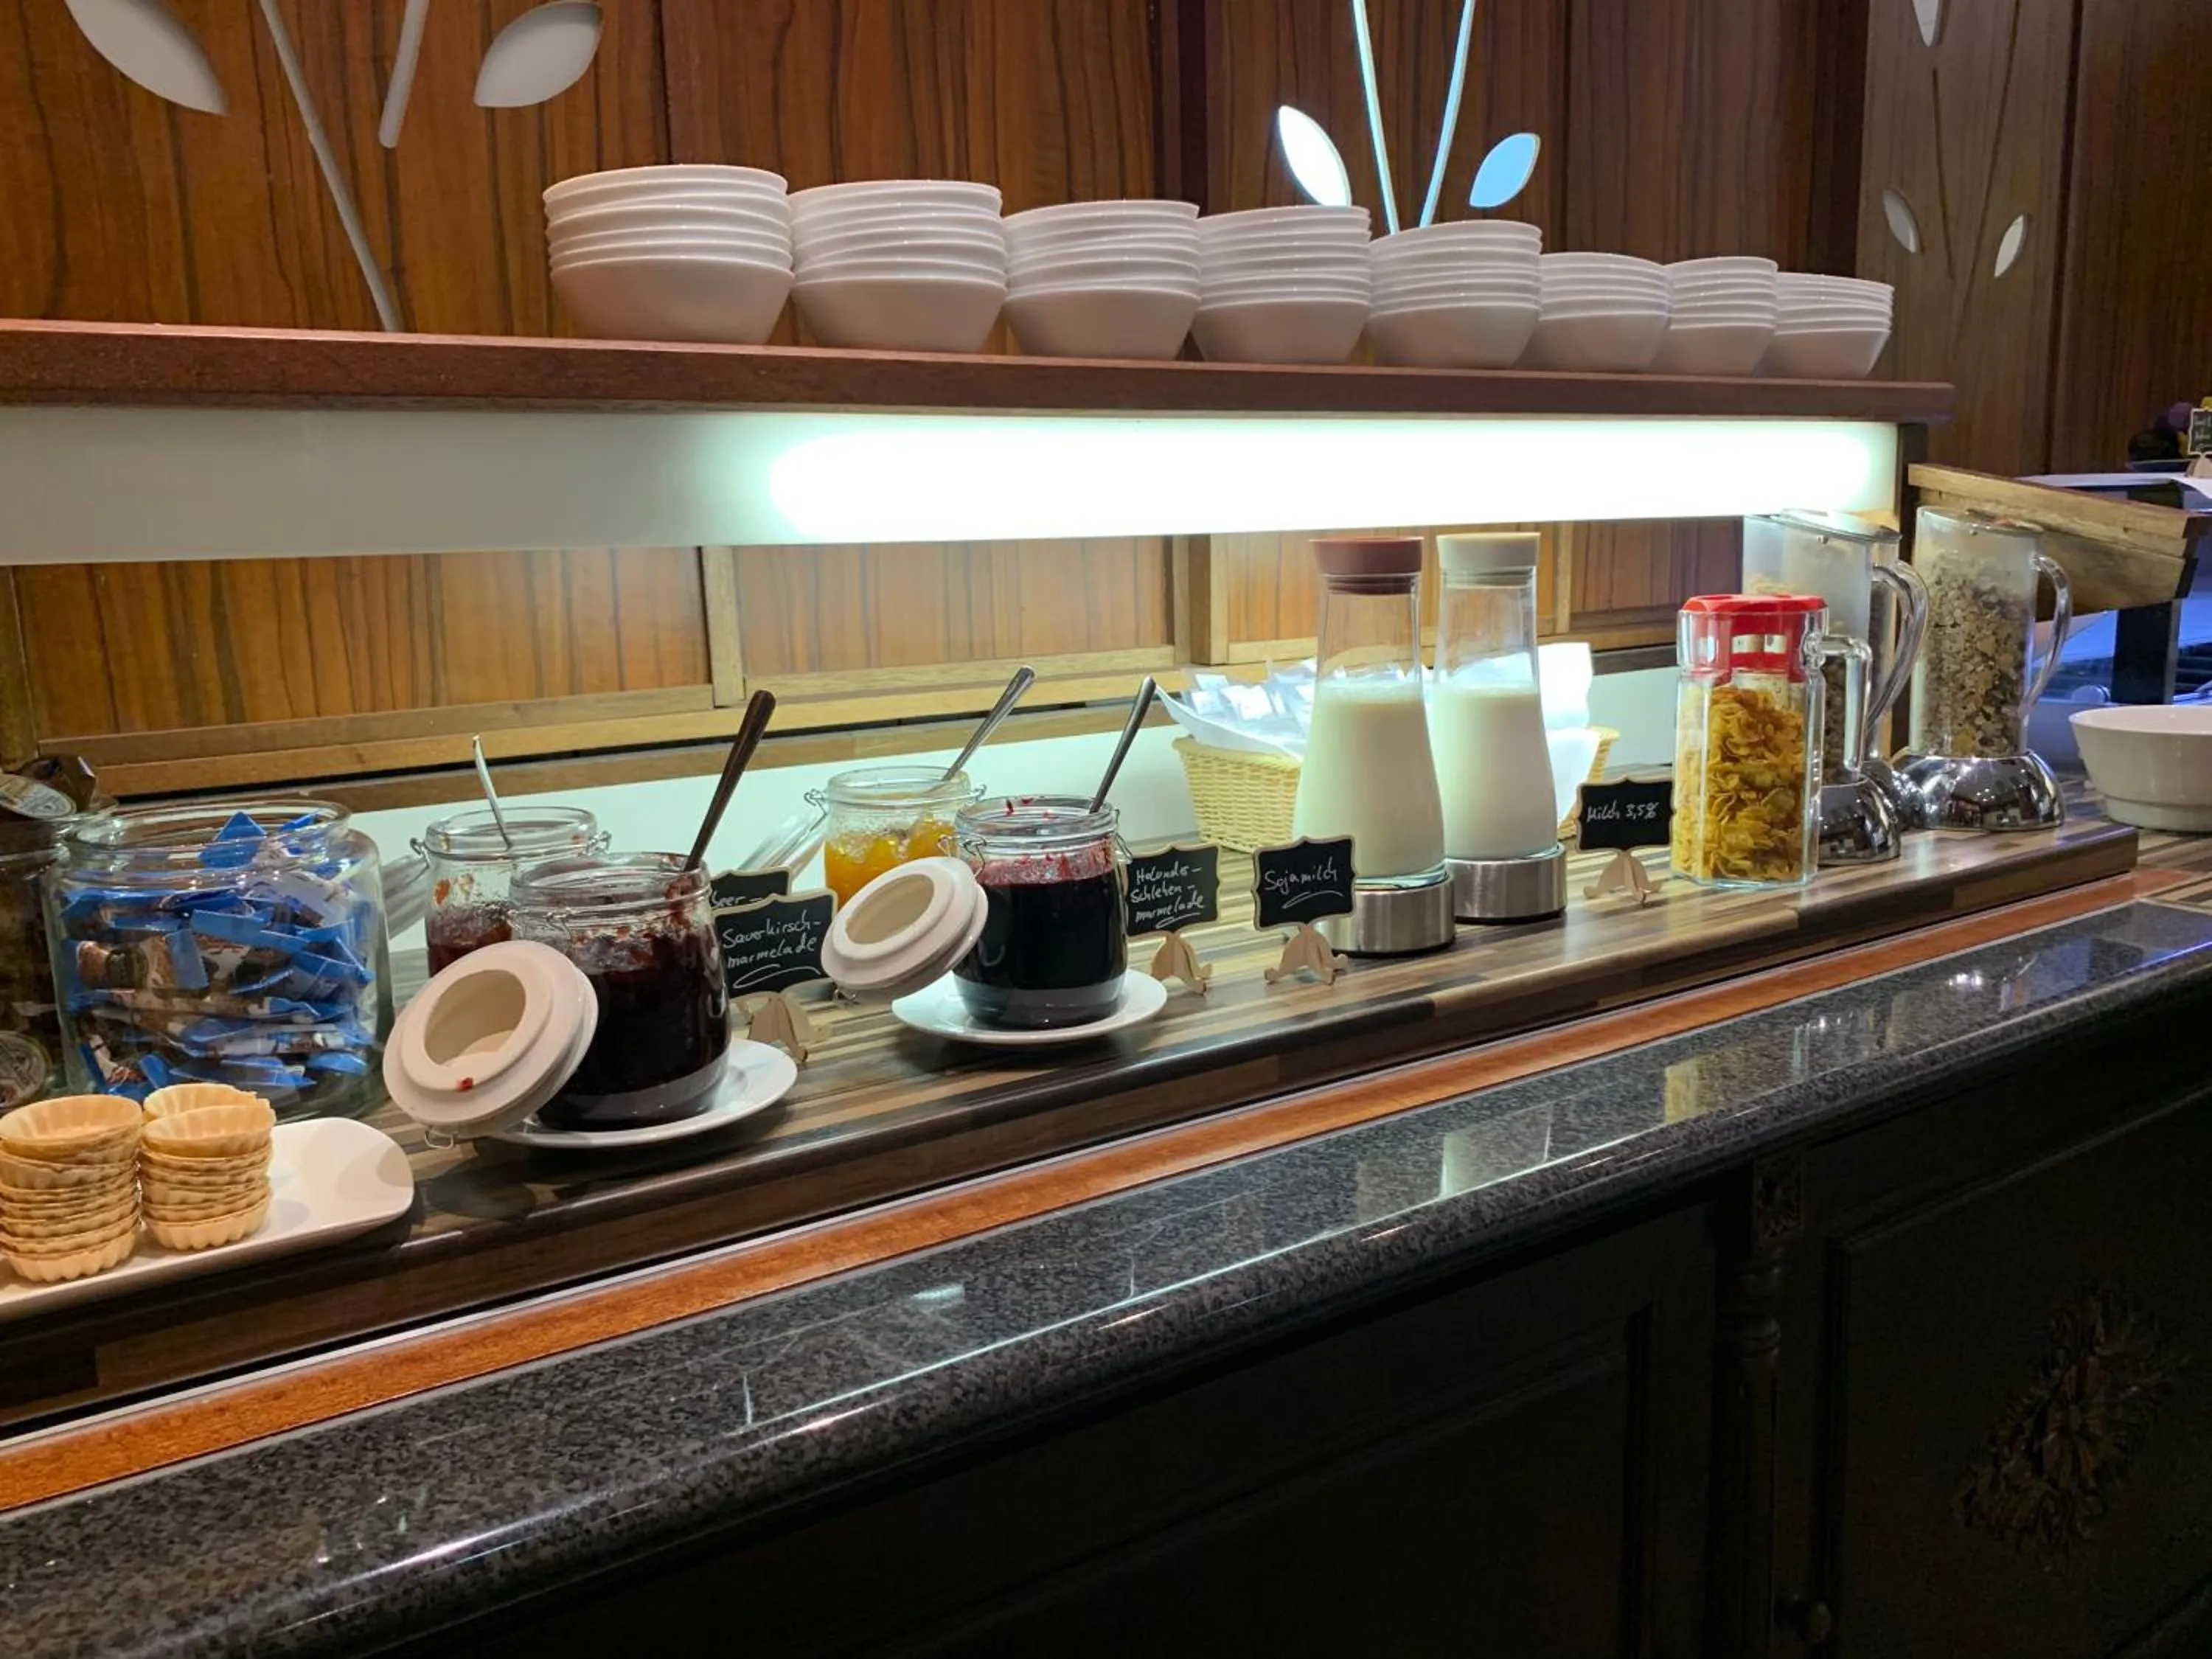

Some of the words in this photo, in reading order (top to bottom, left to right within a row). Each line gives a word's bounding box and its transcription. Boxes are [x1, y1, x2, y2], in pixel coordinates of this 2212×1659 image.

[1586, 799, 1621, 824] Milch
[1264, 855, 1338, 895] Sojamilch
[727, 932, 817, 969] marmelade
